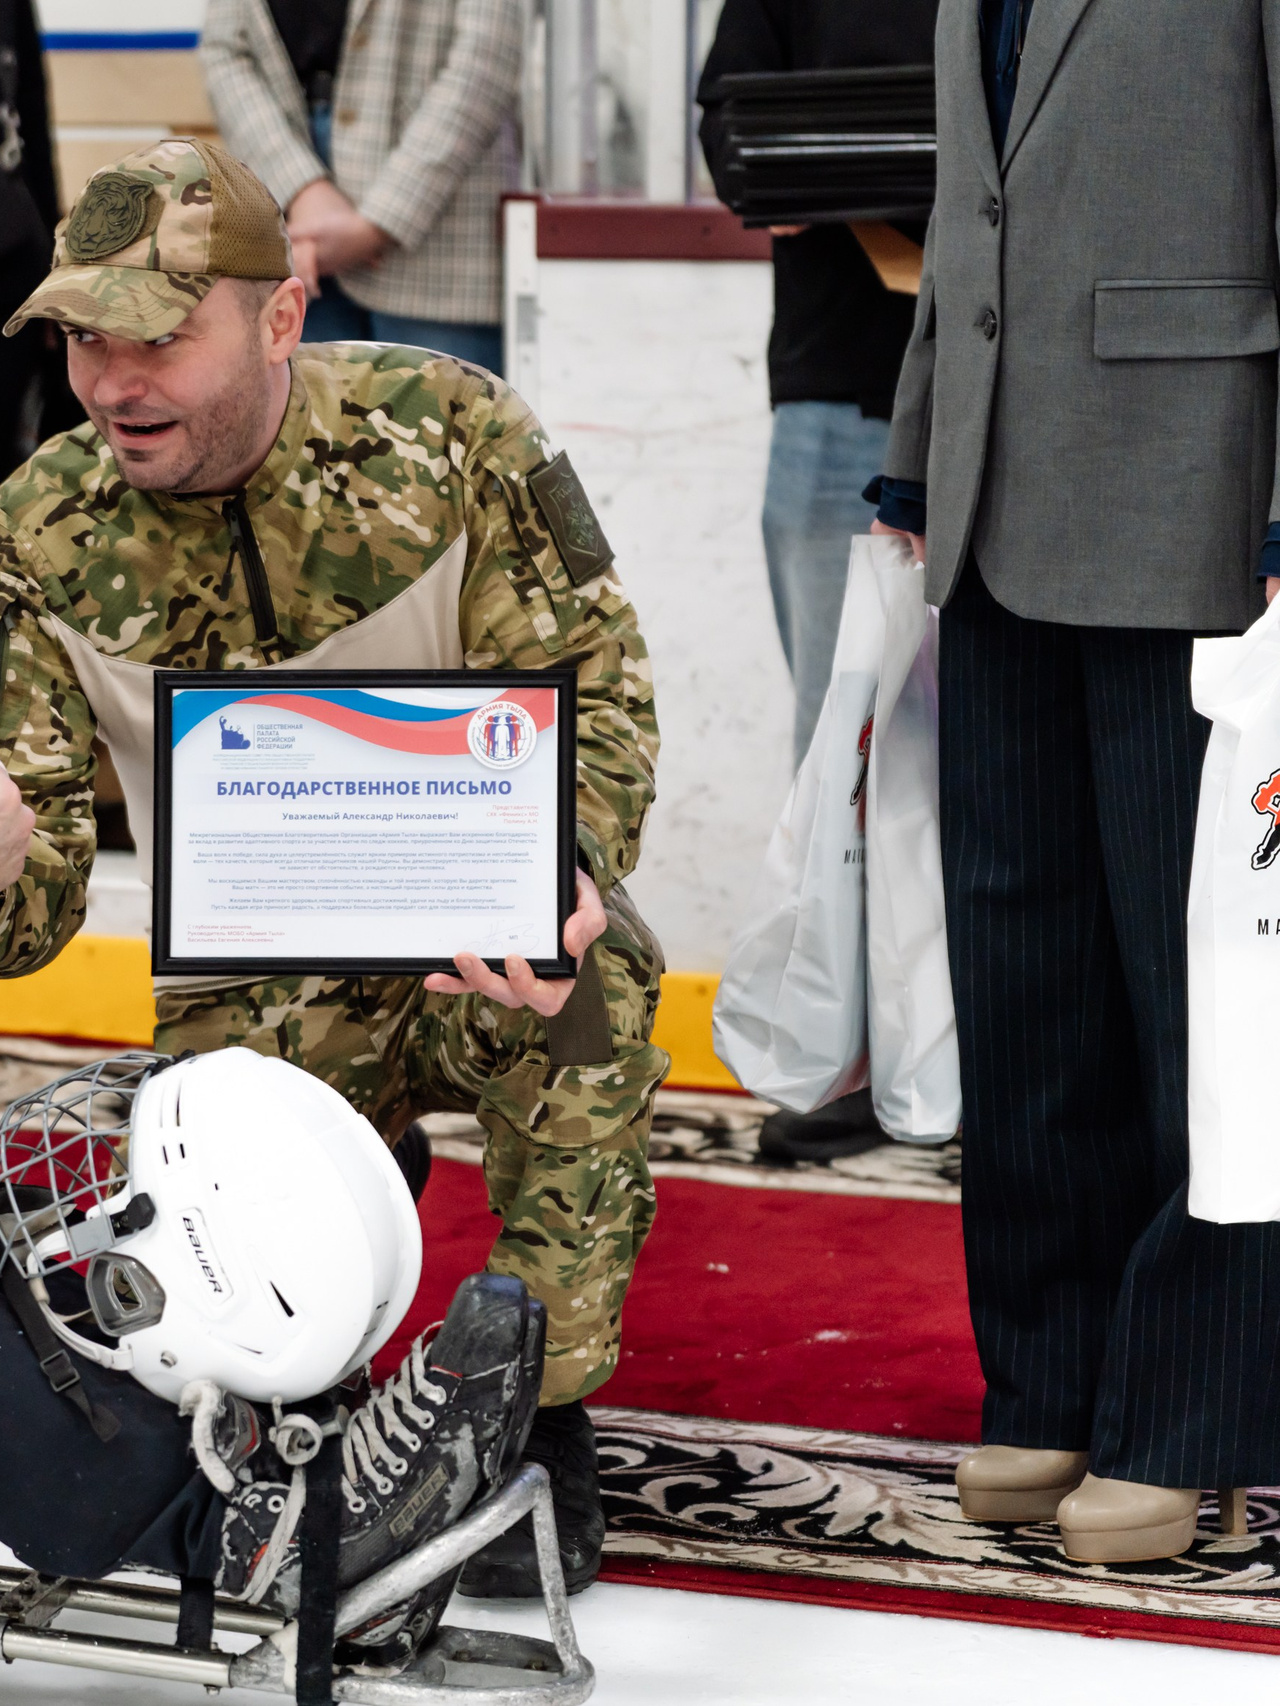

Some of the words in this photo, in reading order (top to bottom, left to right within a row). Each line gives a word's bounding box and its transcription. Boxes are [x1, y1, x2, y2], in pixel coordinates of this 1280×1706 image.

[477, 703, 504, 720] АРМИЯ
[506, 704, 527, 720] ТЫЛА
[217, 780, 420, 799] БЛАГОДАРСТВЕННОЕ
[426, 780, 512, 795] ПИСЬМО
[342, 812, 394, 821] Александр
[182, 1217, 223, 1293] BAUER
